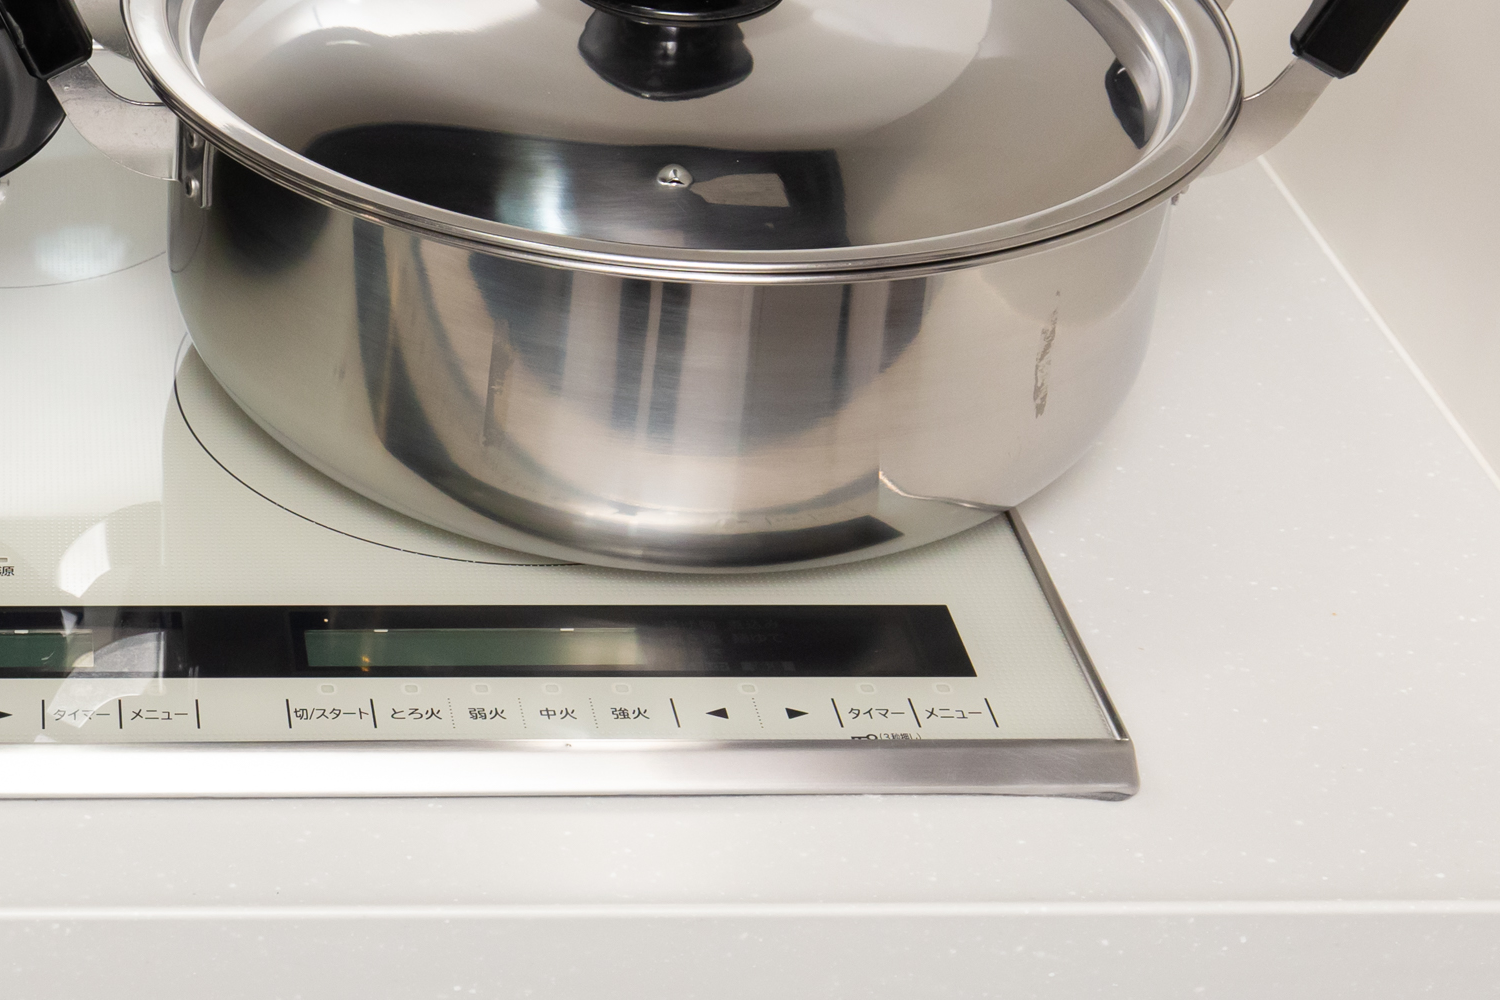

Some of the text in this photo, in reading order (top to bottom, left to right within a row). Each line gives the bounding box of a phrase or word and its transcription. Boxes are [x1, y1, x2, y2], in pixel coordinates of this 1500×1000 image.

[53, 708, 111, 721] タイマー
[130, 708, 189, 721] メニュー
[293, 707, 370, 721] 切/スタート
[390, 707, 443, 720] とろ火
[467, 707, 507, 720] 弱火
[539, 707, 578, 720] 中火
[610, 707, 651, 720] 強火
[848, 707, 906, 720] タイマー
[925, 707, 983, 720] メニュー
